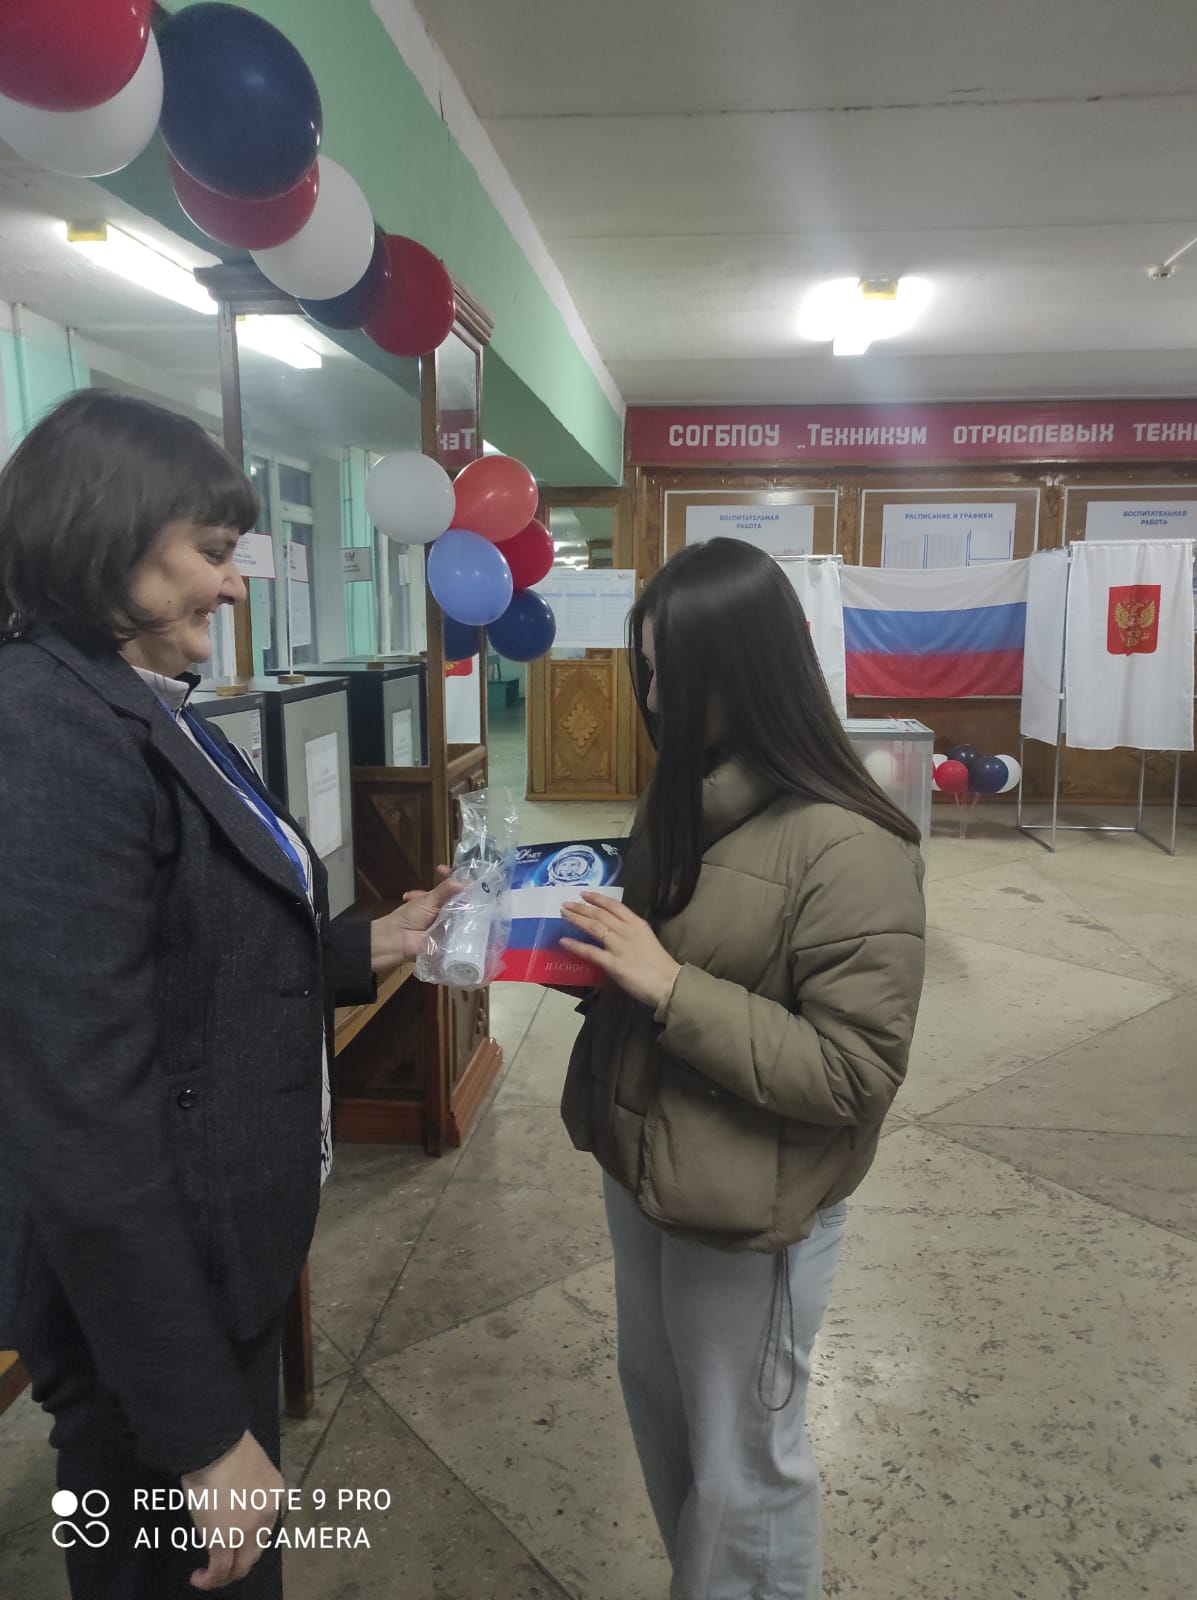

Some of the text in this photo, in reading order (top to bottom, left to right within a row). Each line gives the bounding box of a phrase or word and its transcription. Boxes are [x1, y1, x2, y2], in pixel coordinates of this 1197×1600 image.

[668, 424, 780, 447] СОГБПОУ
[953, 424, 1115, 444] ОТРАСЛЕВЫХ
[1133, 423, 1197, 442] ТЕХН
[904, 512, 951, 520] РАСПИСАНИЕ
